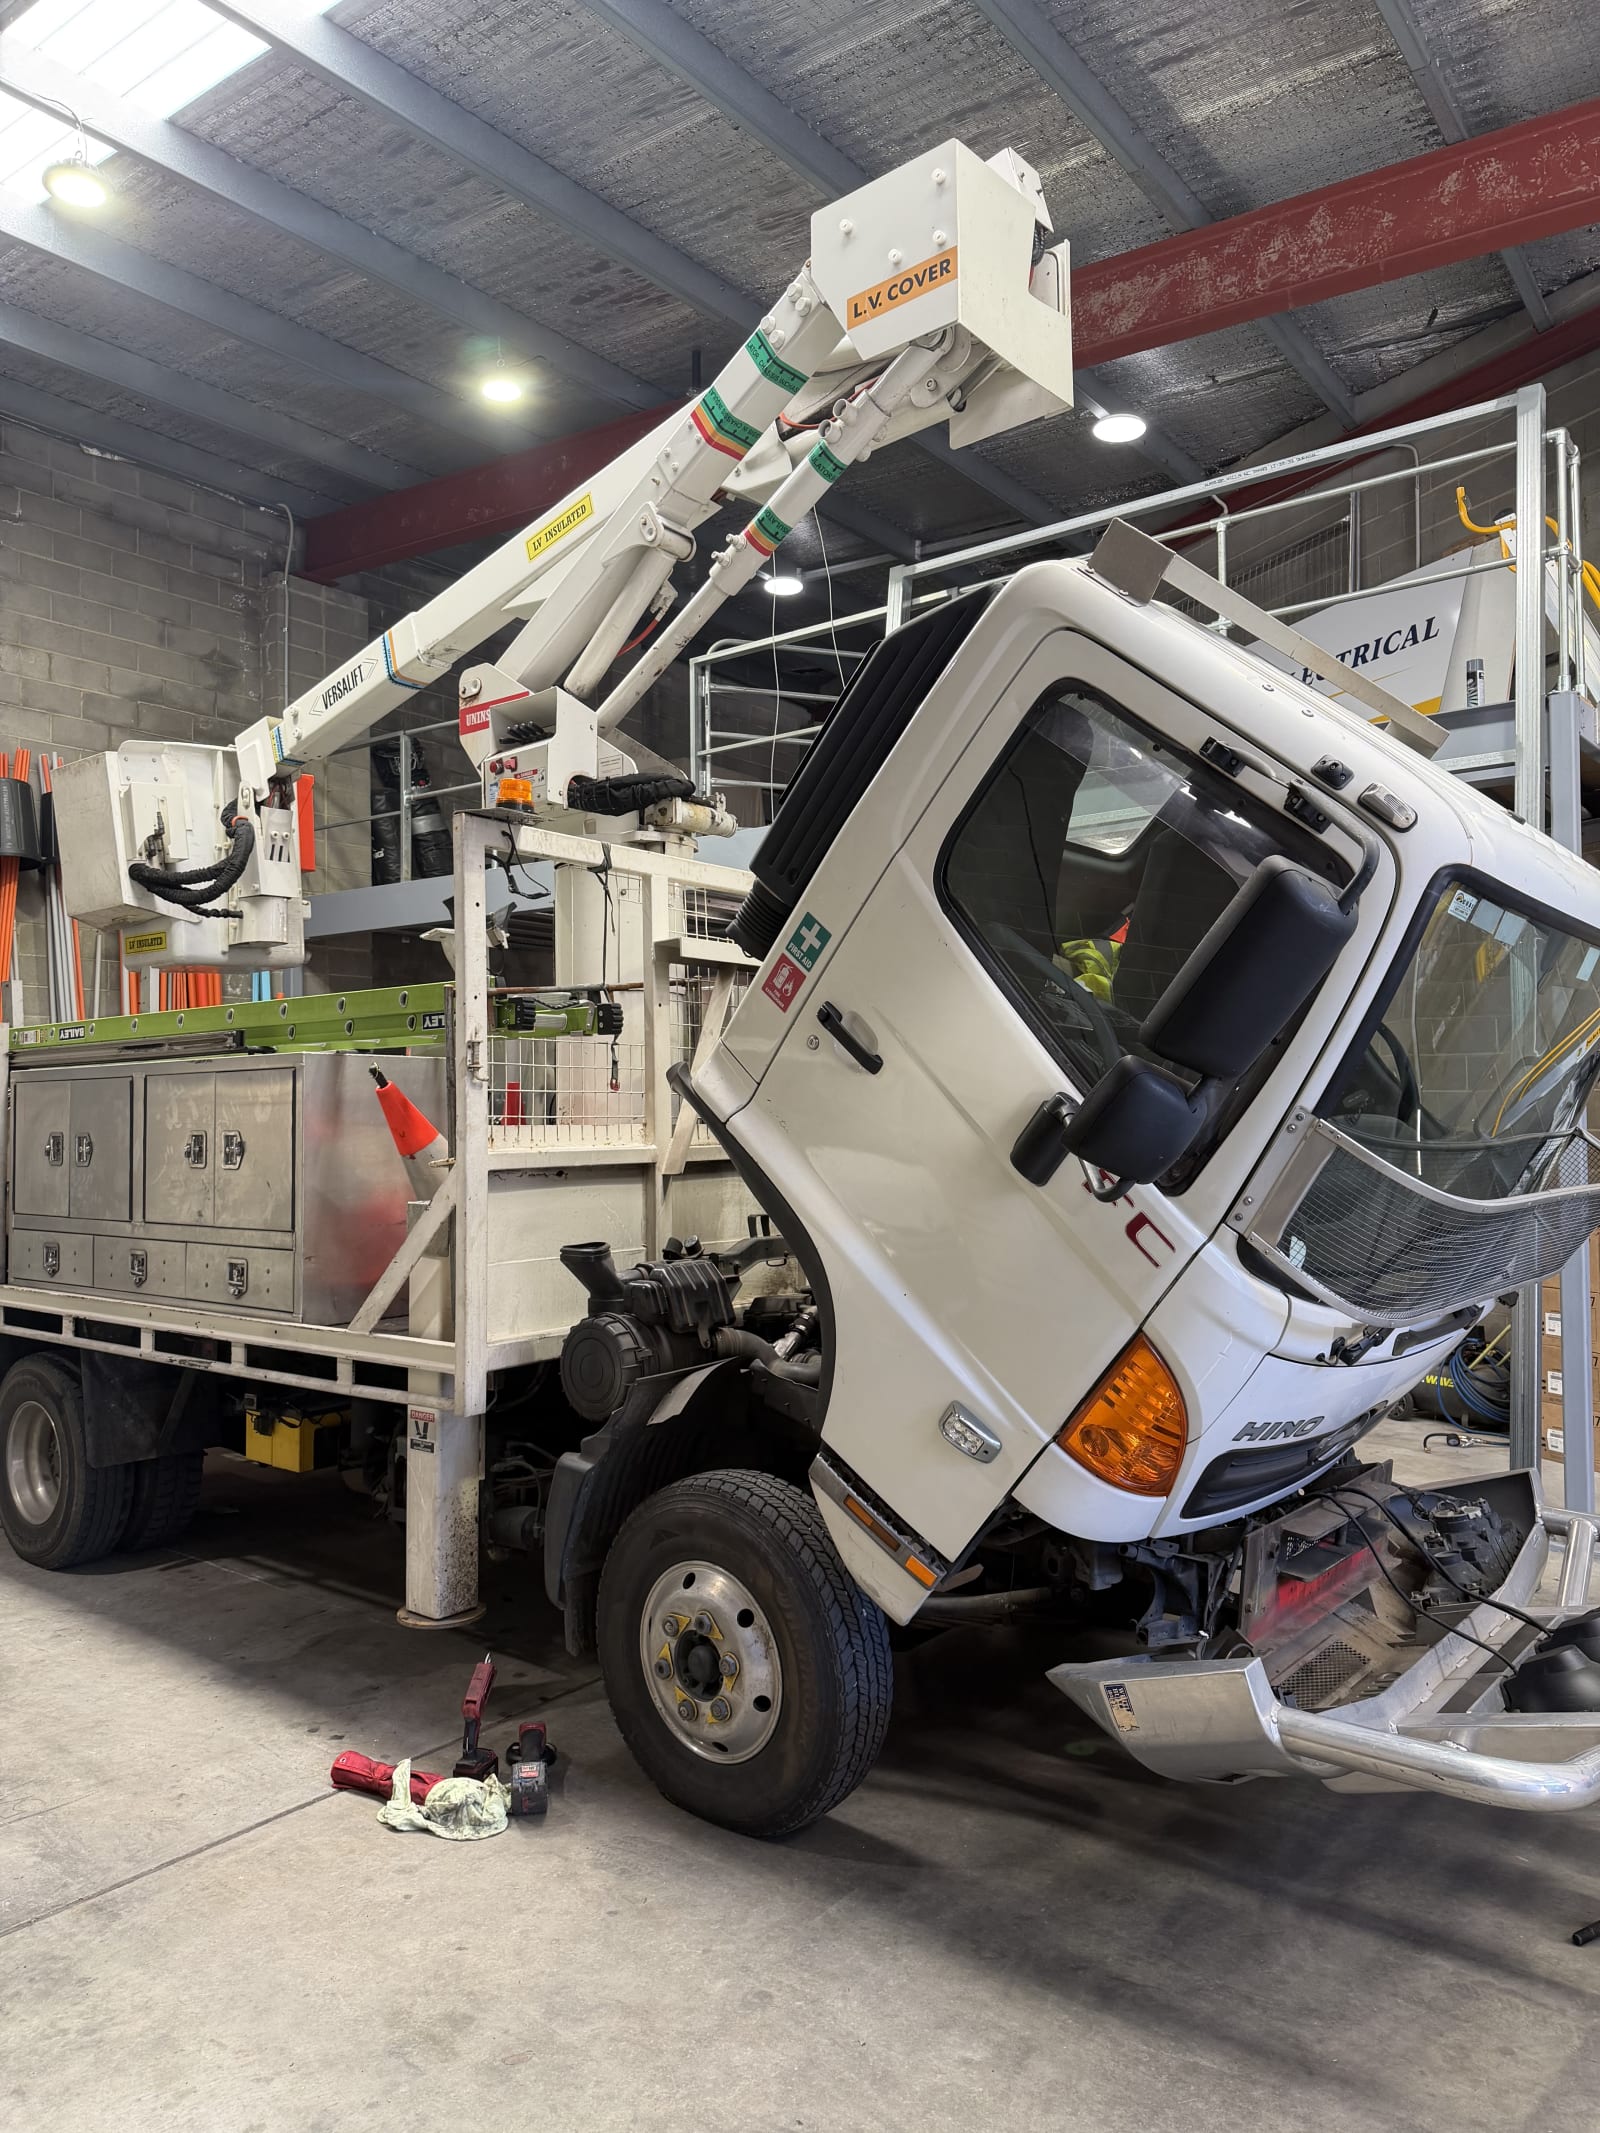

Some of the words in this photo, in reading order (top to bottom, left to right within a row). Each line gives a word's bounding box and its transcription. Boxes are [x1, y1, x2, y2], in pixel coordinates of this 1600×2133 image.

[854, 288, 882, 319] L.V.
[888, 258, 951, 301] COVER
[532, 537, 542, 552] LV
[544, 504, 587, 543] INSULATED
[1290, 616, 1440, 686] ETRICAL
[322, 664, 364, 710] VERSALIFT
[787, 942, 804, 960] FIRST
[802, 955, 813, 968] AID
[60, 1027, 84, 1039] BAILEY
[1232, 1406, 1325, 1442] HINO
